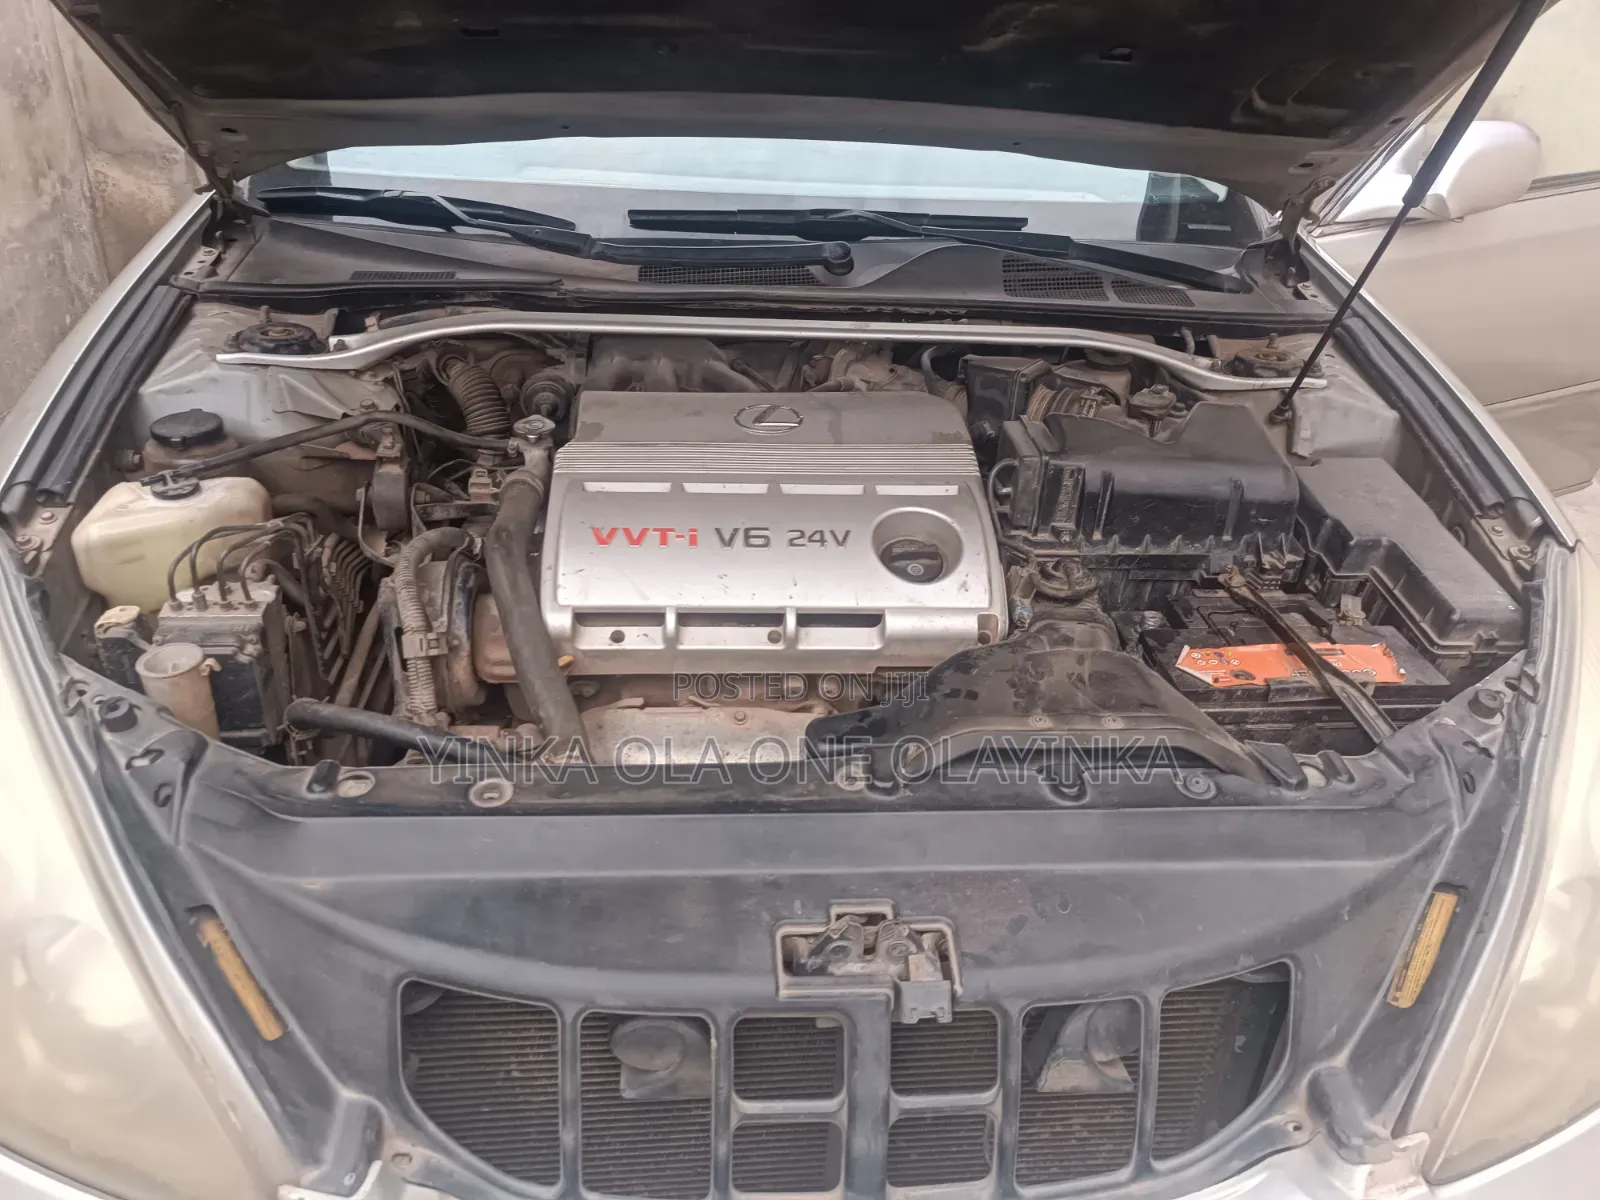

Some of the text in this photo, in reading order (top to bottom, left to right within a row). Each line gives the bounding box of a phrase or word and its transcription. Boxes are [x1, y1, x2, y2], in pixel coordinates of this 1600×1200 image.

[591, 527, 852, 549] VVT-i V6 24V
